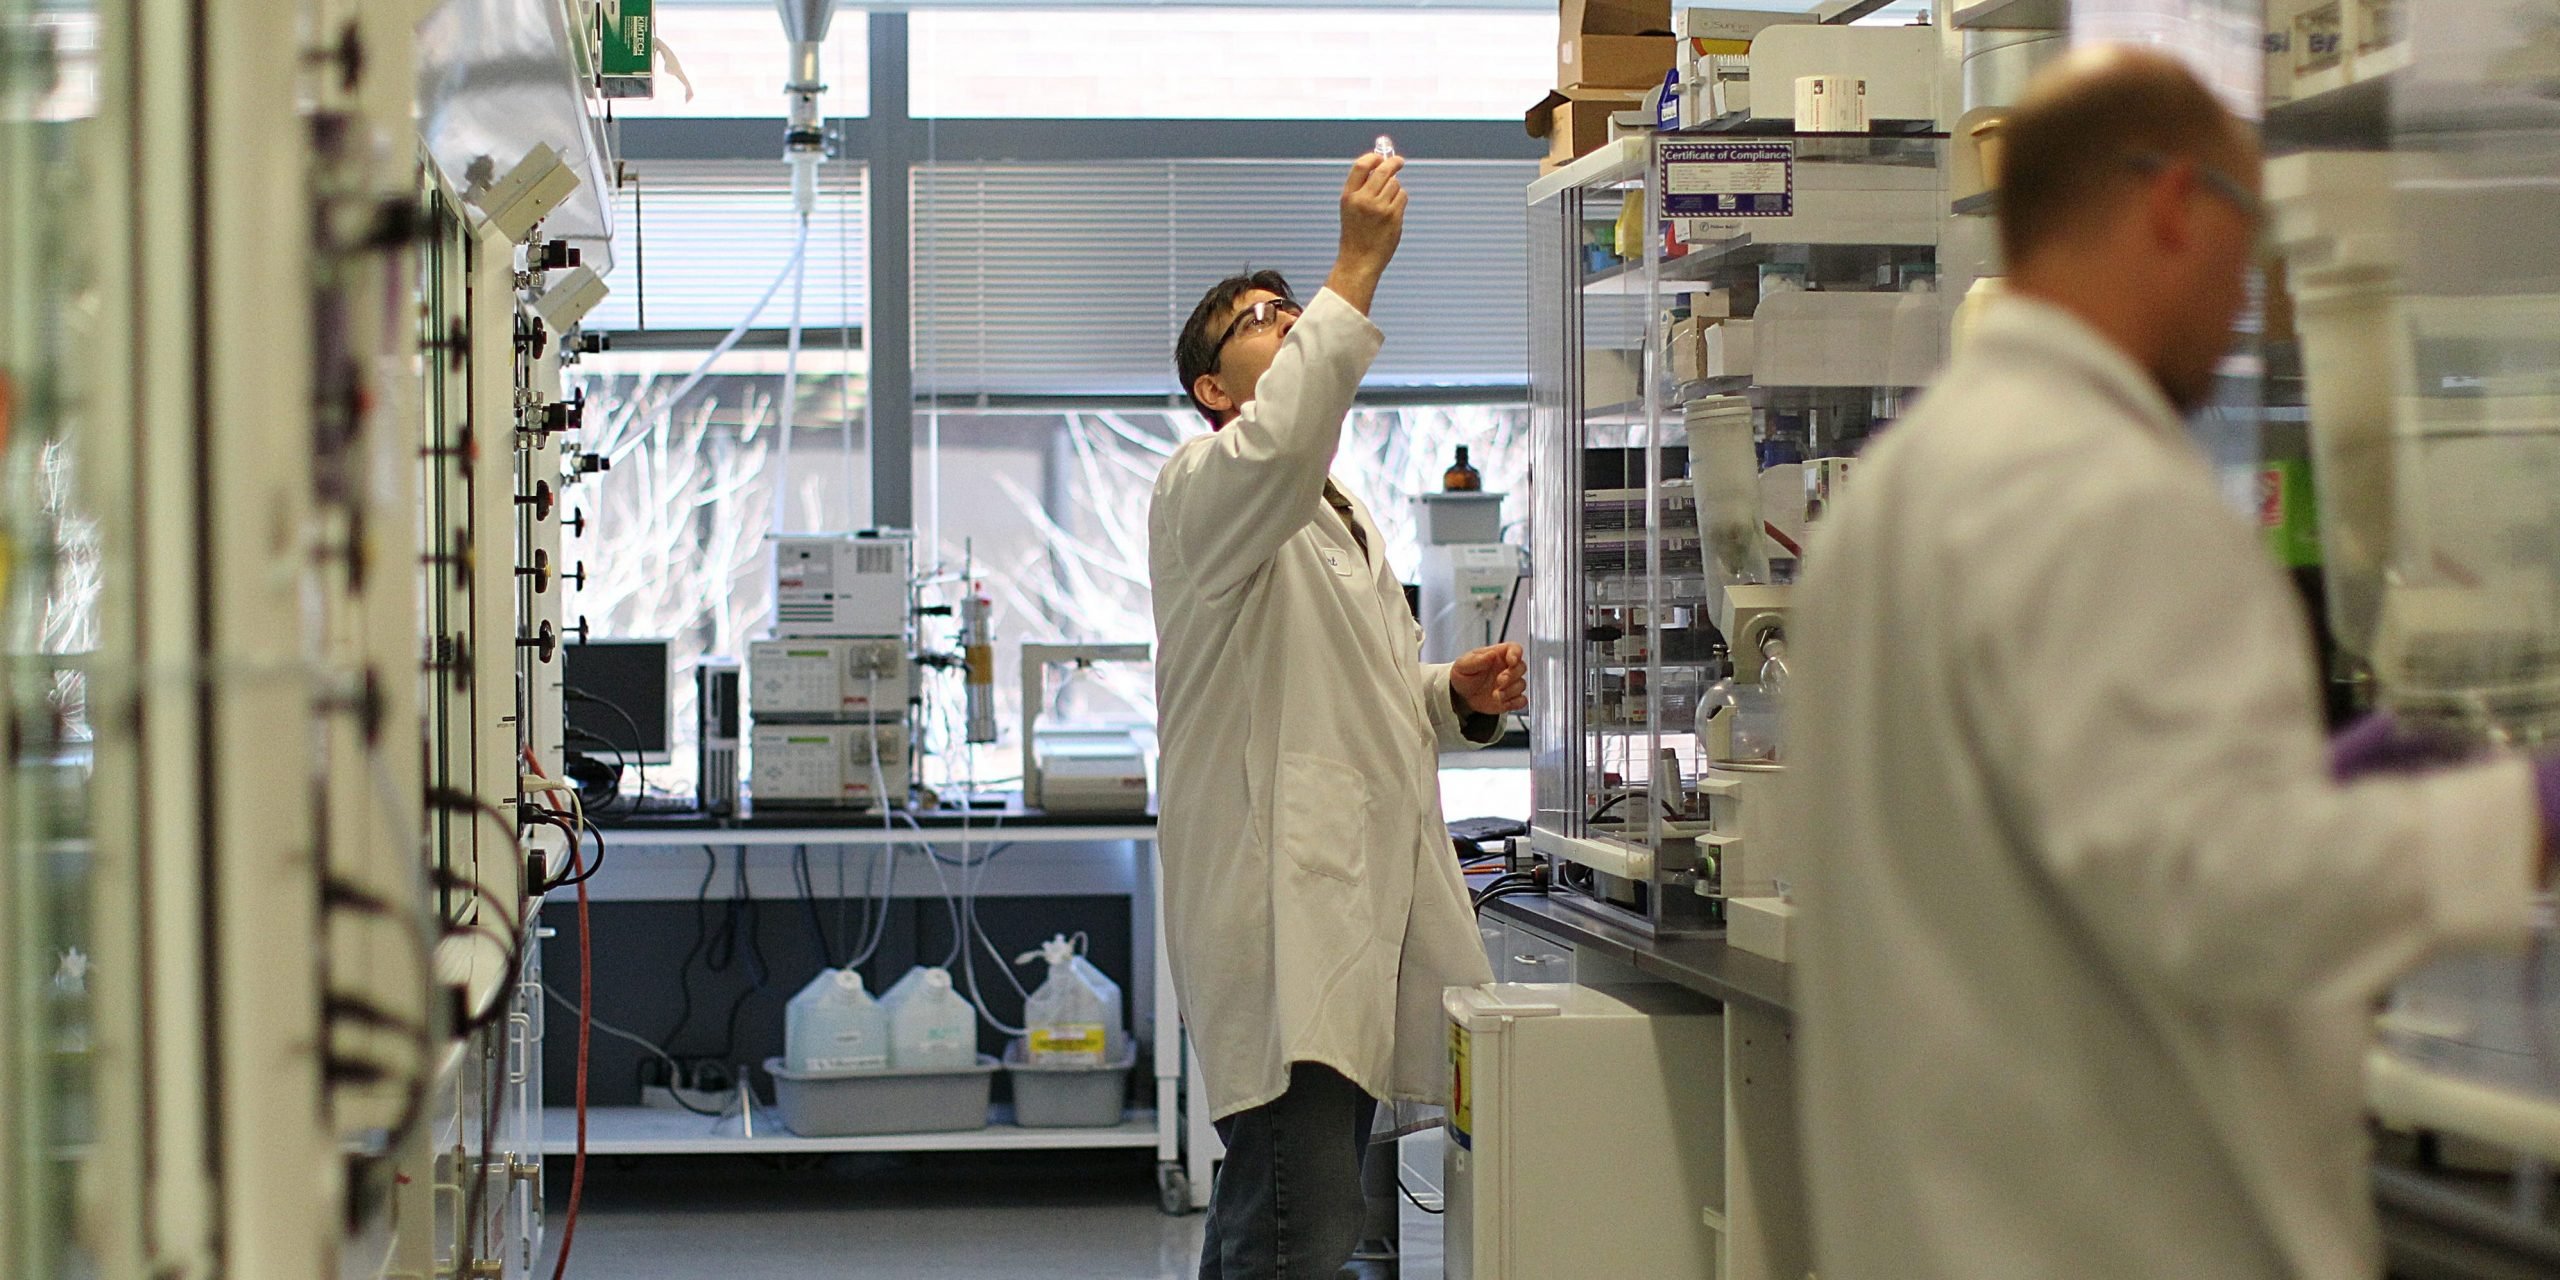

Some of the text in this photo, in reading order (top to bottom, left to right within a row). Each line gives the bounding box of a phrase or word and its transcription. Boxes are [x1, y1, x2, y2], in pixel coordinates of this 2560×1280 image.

[1665, 150, 1787, 162] Certificate of Compliance
